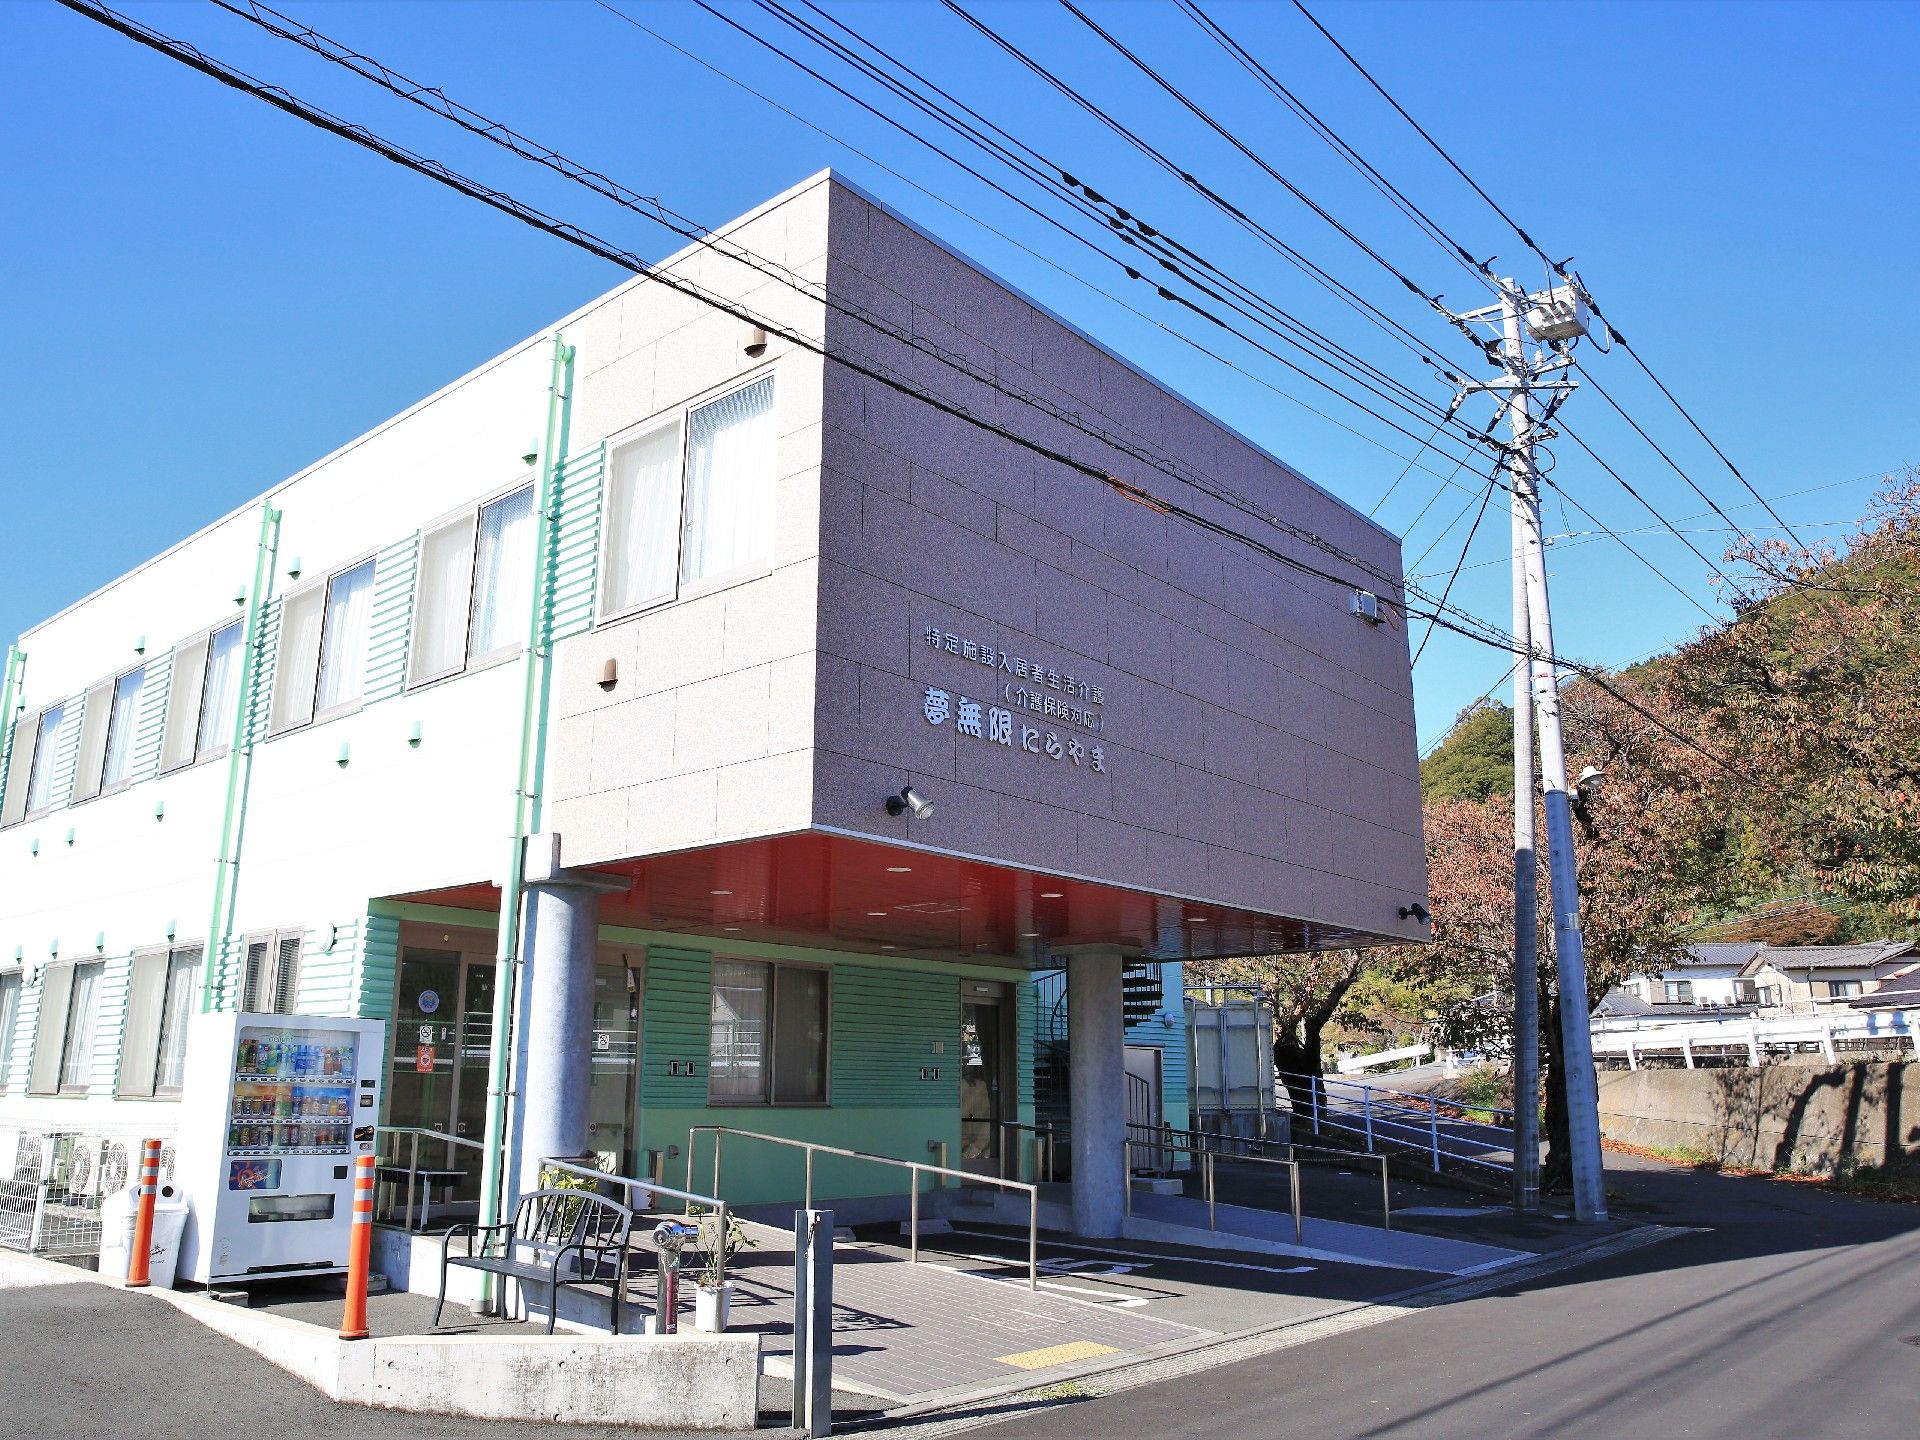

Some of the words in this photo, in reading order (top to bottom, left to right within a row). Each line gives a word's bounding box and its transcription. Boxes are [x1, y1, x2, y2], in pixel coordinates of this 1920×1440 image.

[925, 625, 1104, 705] 特定施設入居者生活介護
[924, 687, 1106, 773] 夢無限にらやま
